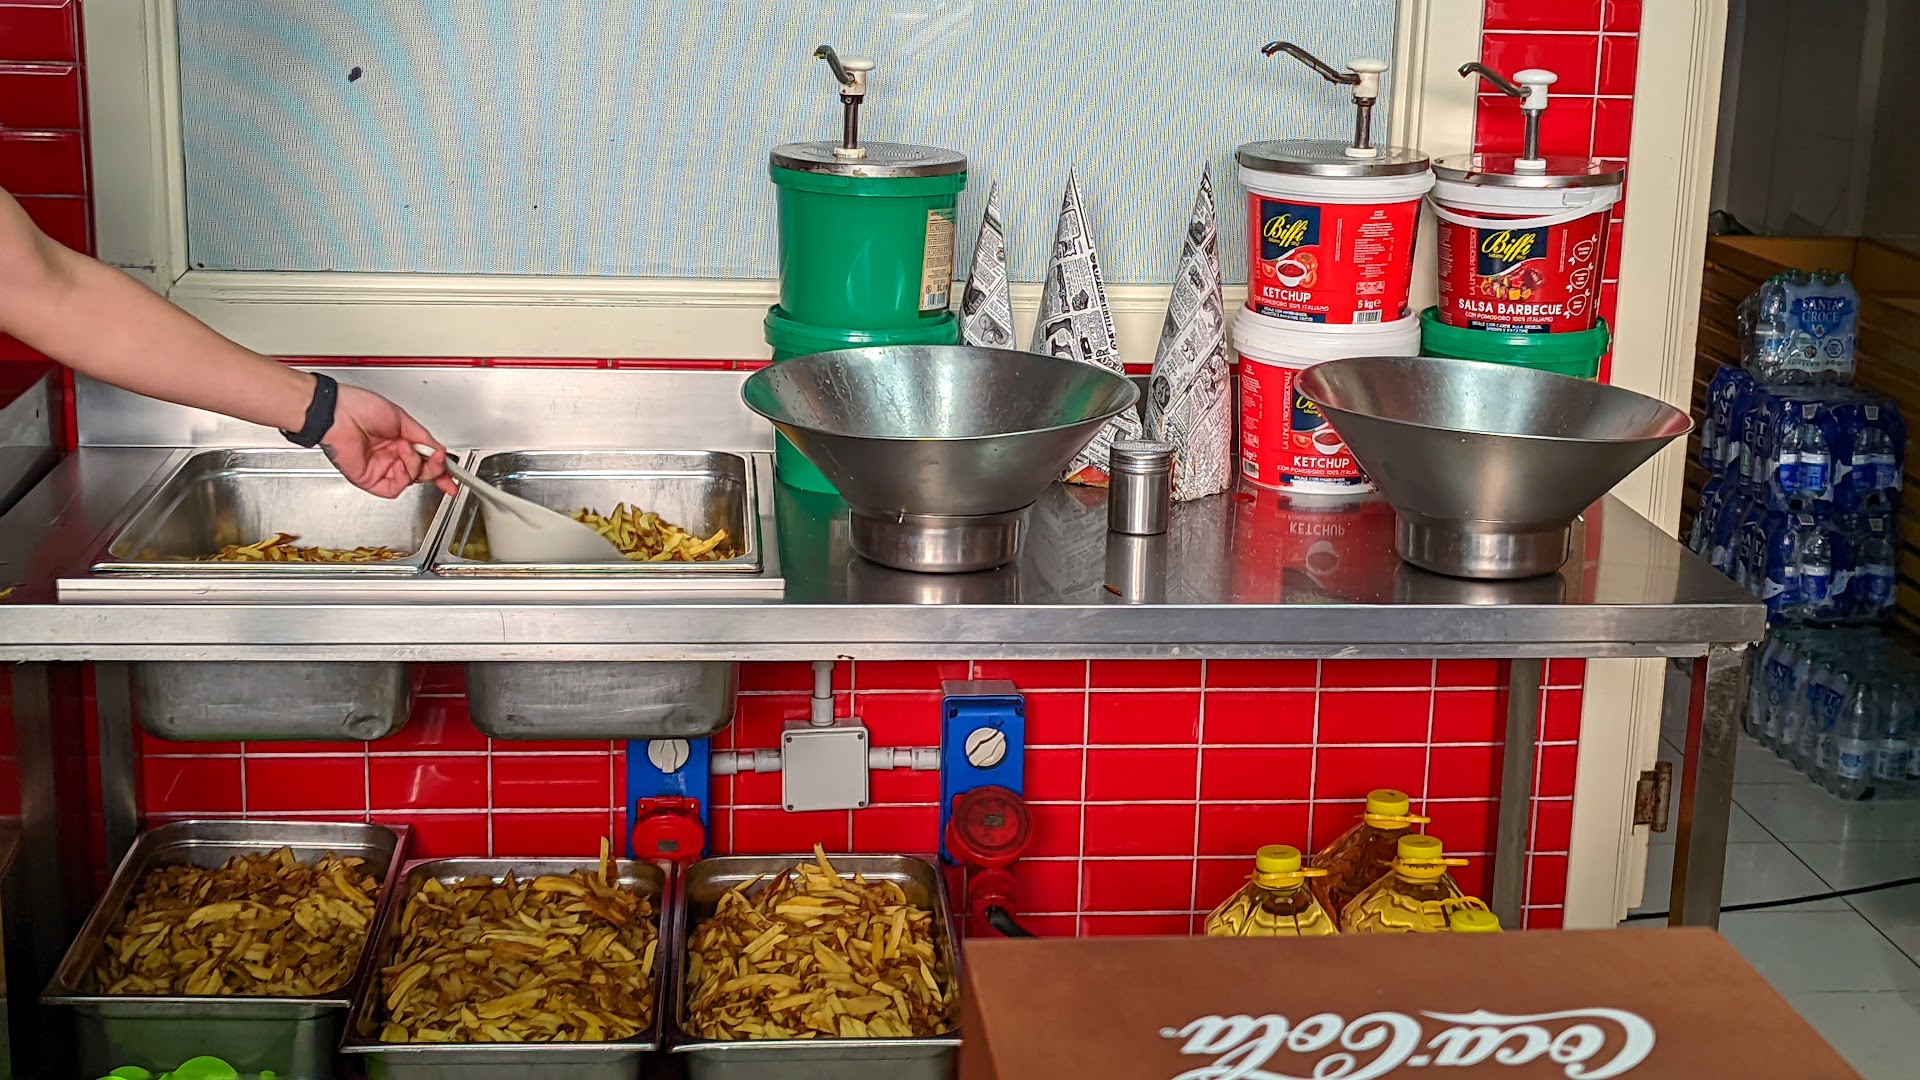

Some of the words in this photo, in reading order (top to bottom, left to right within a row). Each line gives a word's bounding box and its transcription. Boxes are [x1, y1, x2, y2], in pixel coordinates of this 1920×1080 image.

[1263, 213, 1309, 248] Biffi
[1481, 229, 1537, 262] Biffi
[1263, 285, 1312, 303] KETCHUP
[1458, 298, 1494, 314] SALSA
[1497, 303, 1563, 316] BARBECUE
[1293, 455, 1350, 469] KETCHUP
[1161, 1007, 1657, 1080] Coca-Cola
